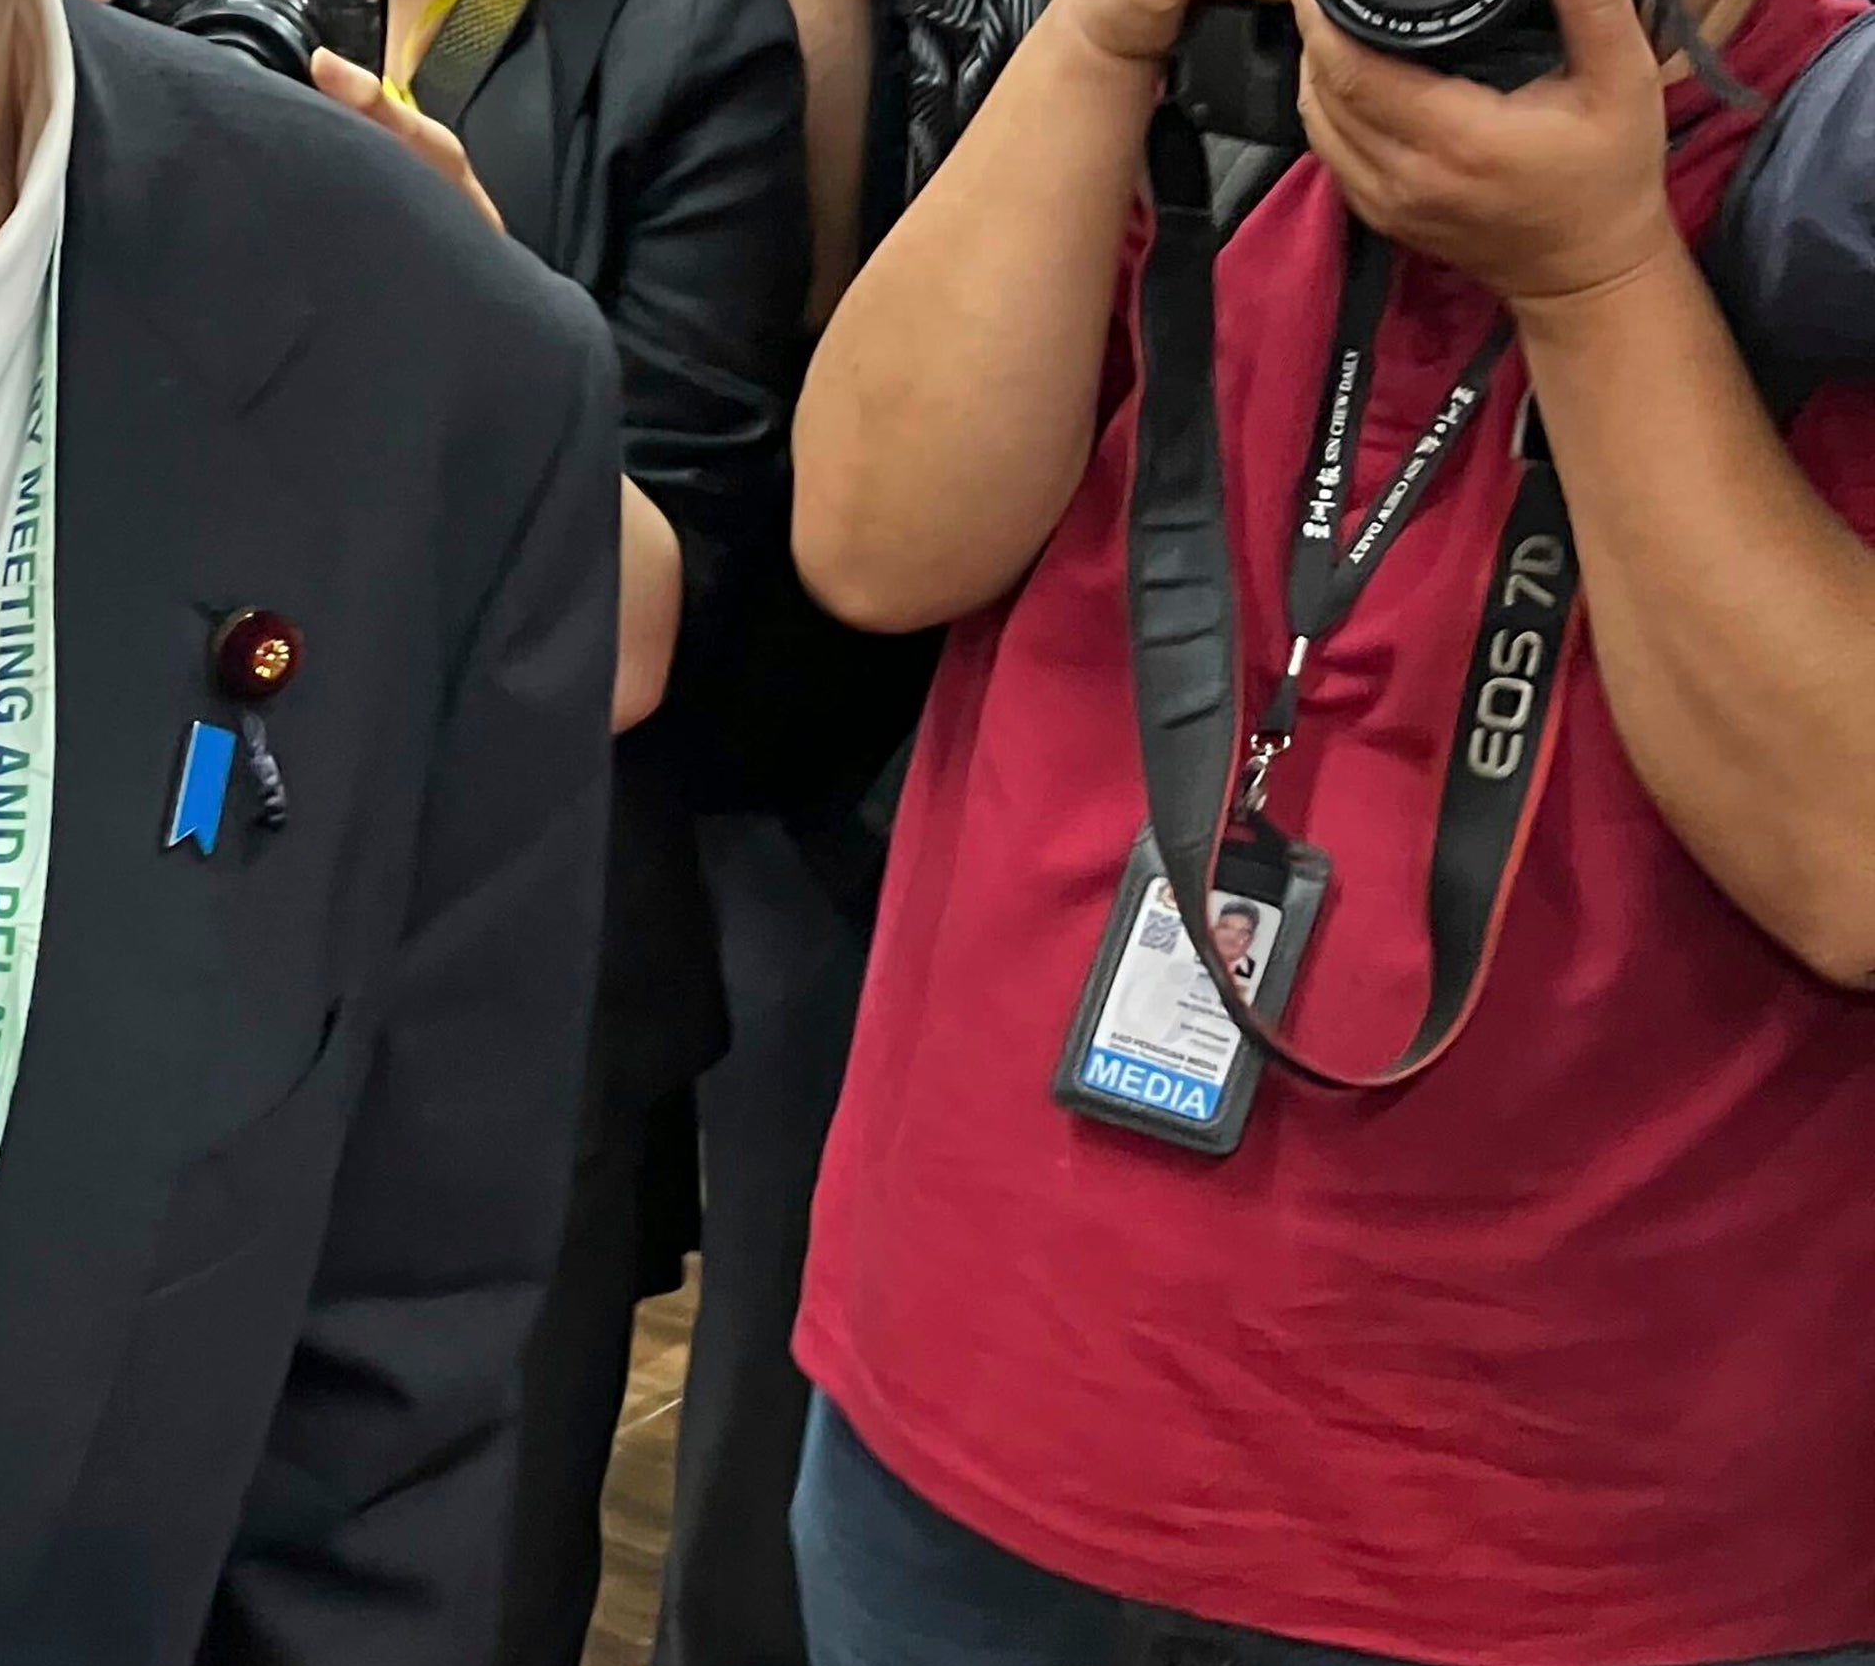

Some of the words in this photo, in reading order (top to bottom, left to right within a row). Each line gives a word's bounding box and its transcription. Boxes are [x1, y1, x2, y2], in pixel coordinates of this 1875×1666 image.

[1504, 534, 1565, 608] 7D
[1468, 629, 1543, 780] EOS
[1086, 1053, 1206, 1119] MEDIA
